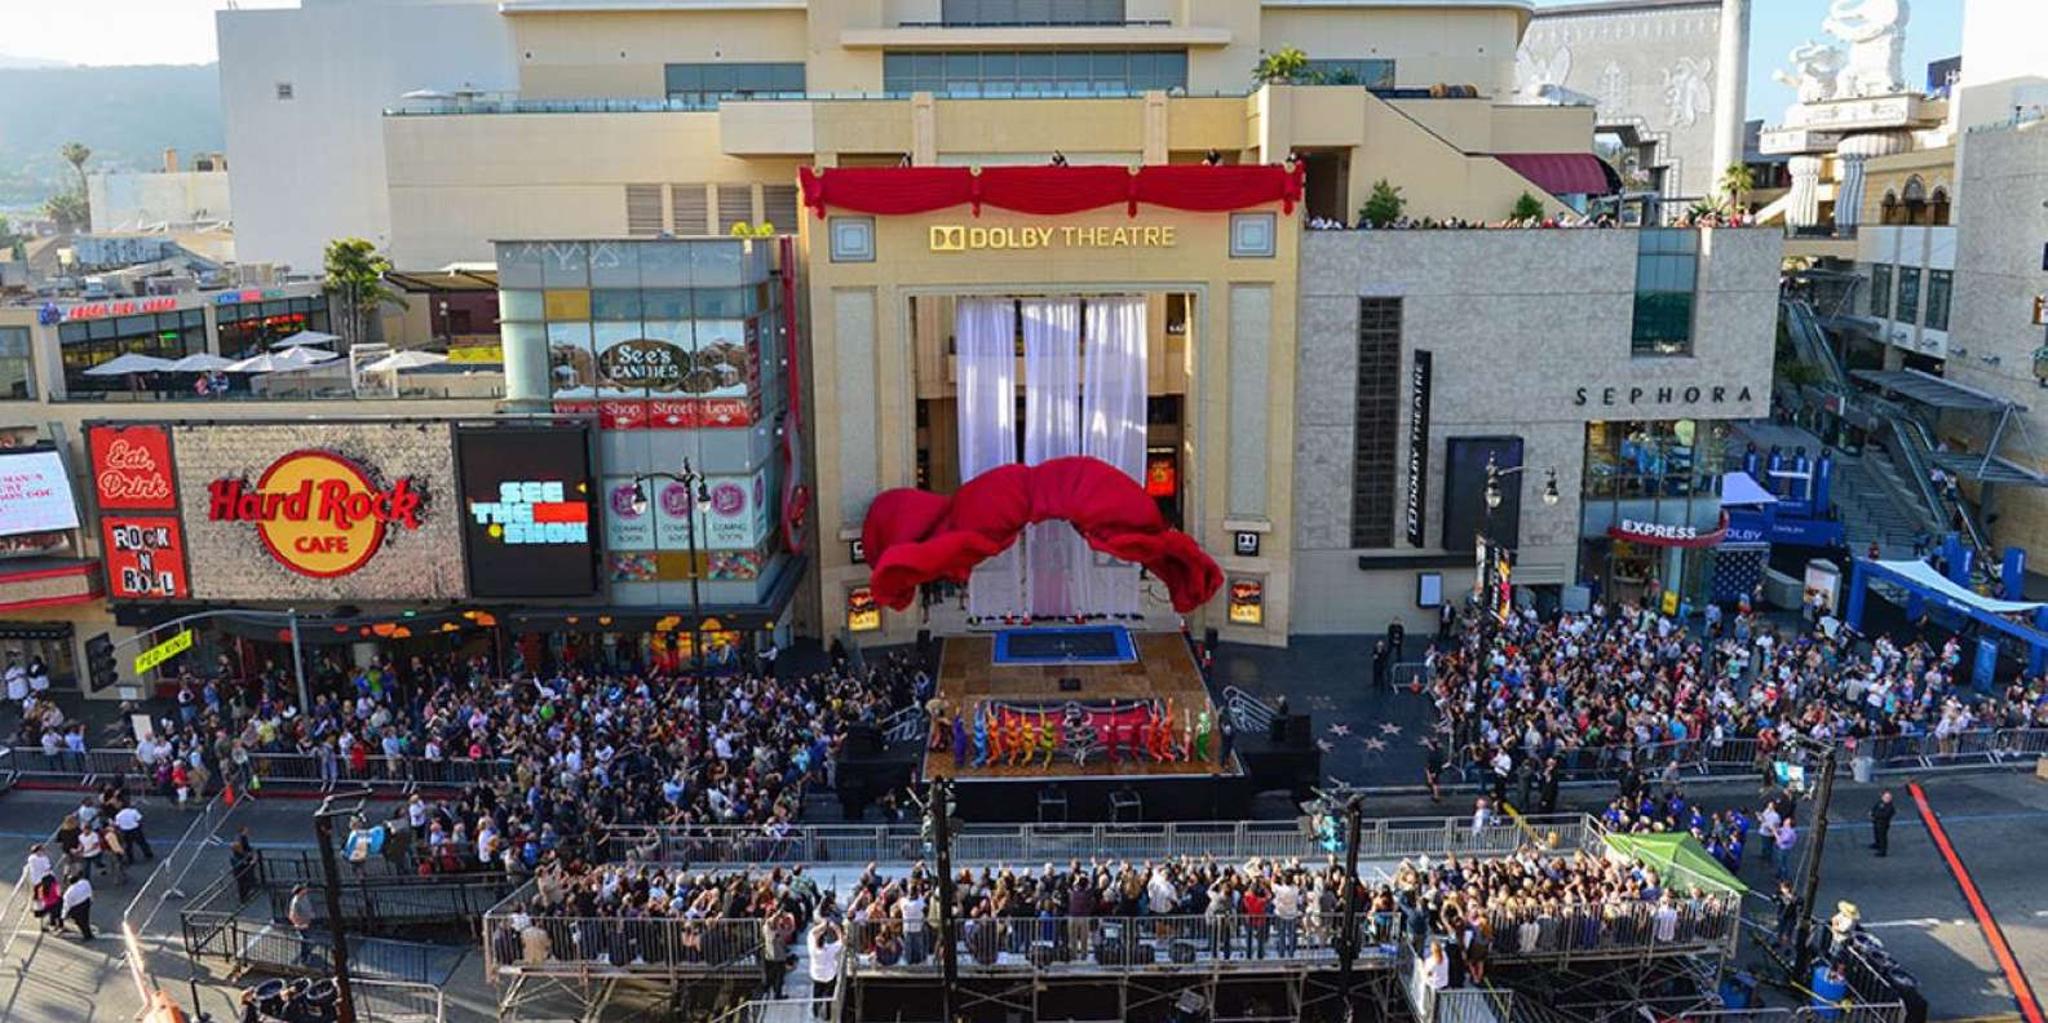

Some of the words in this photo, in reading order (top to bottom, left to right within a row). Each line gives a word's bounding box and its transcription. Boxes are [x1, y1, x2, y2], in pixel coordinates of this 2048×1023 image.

[970, 226, 1052, 249] DOLBY
[1061, 226, 1176, 246] THEATRE
[619, 344, 673, 365] See's
[609, 364, 680, 379] CANDIES
[1412, 362, 1425, 441] THEATRE
[1575, 386, 1752, 406] SEPHORA
[605, 401, 642, 416] Shop
[652, 401, 693, 415] Street
[107, 438, 155, 471] Eat,
[98, 469, 170, 499] Drink
[1409, 447, 1420, 509] DOLBY
[500, 481, 564, 503] SEE
[207, 479, 314, 522] Hard
[316, 478, 423, 531] Rock
[470, 502, 534, 524] THE
[113, 525, 171, 551] ROCK
[504, 522, 588, 544] SHOW
[1621, 519, 1696, 541] EXPRESS
[294, 535, 350, 554] CAFE
[136, 550, 153, 573] N
[122, 567, 175, 596] ROLL
[139, 650, 162, 668] PED
